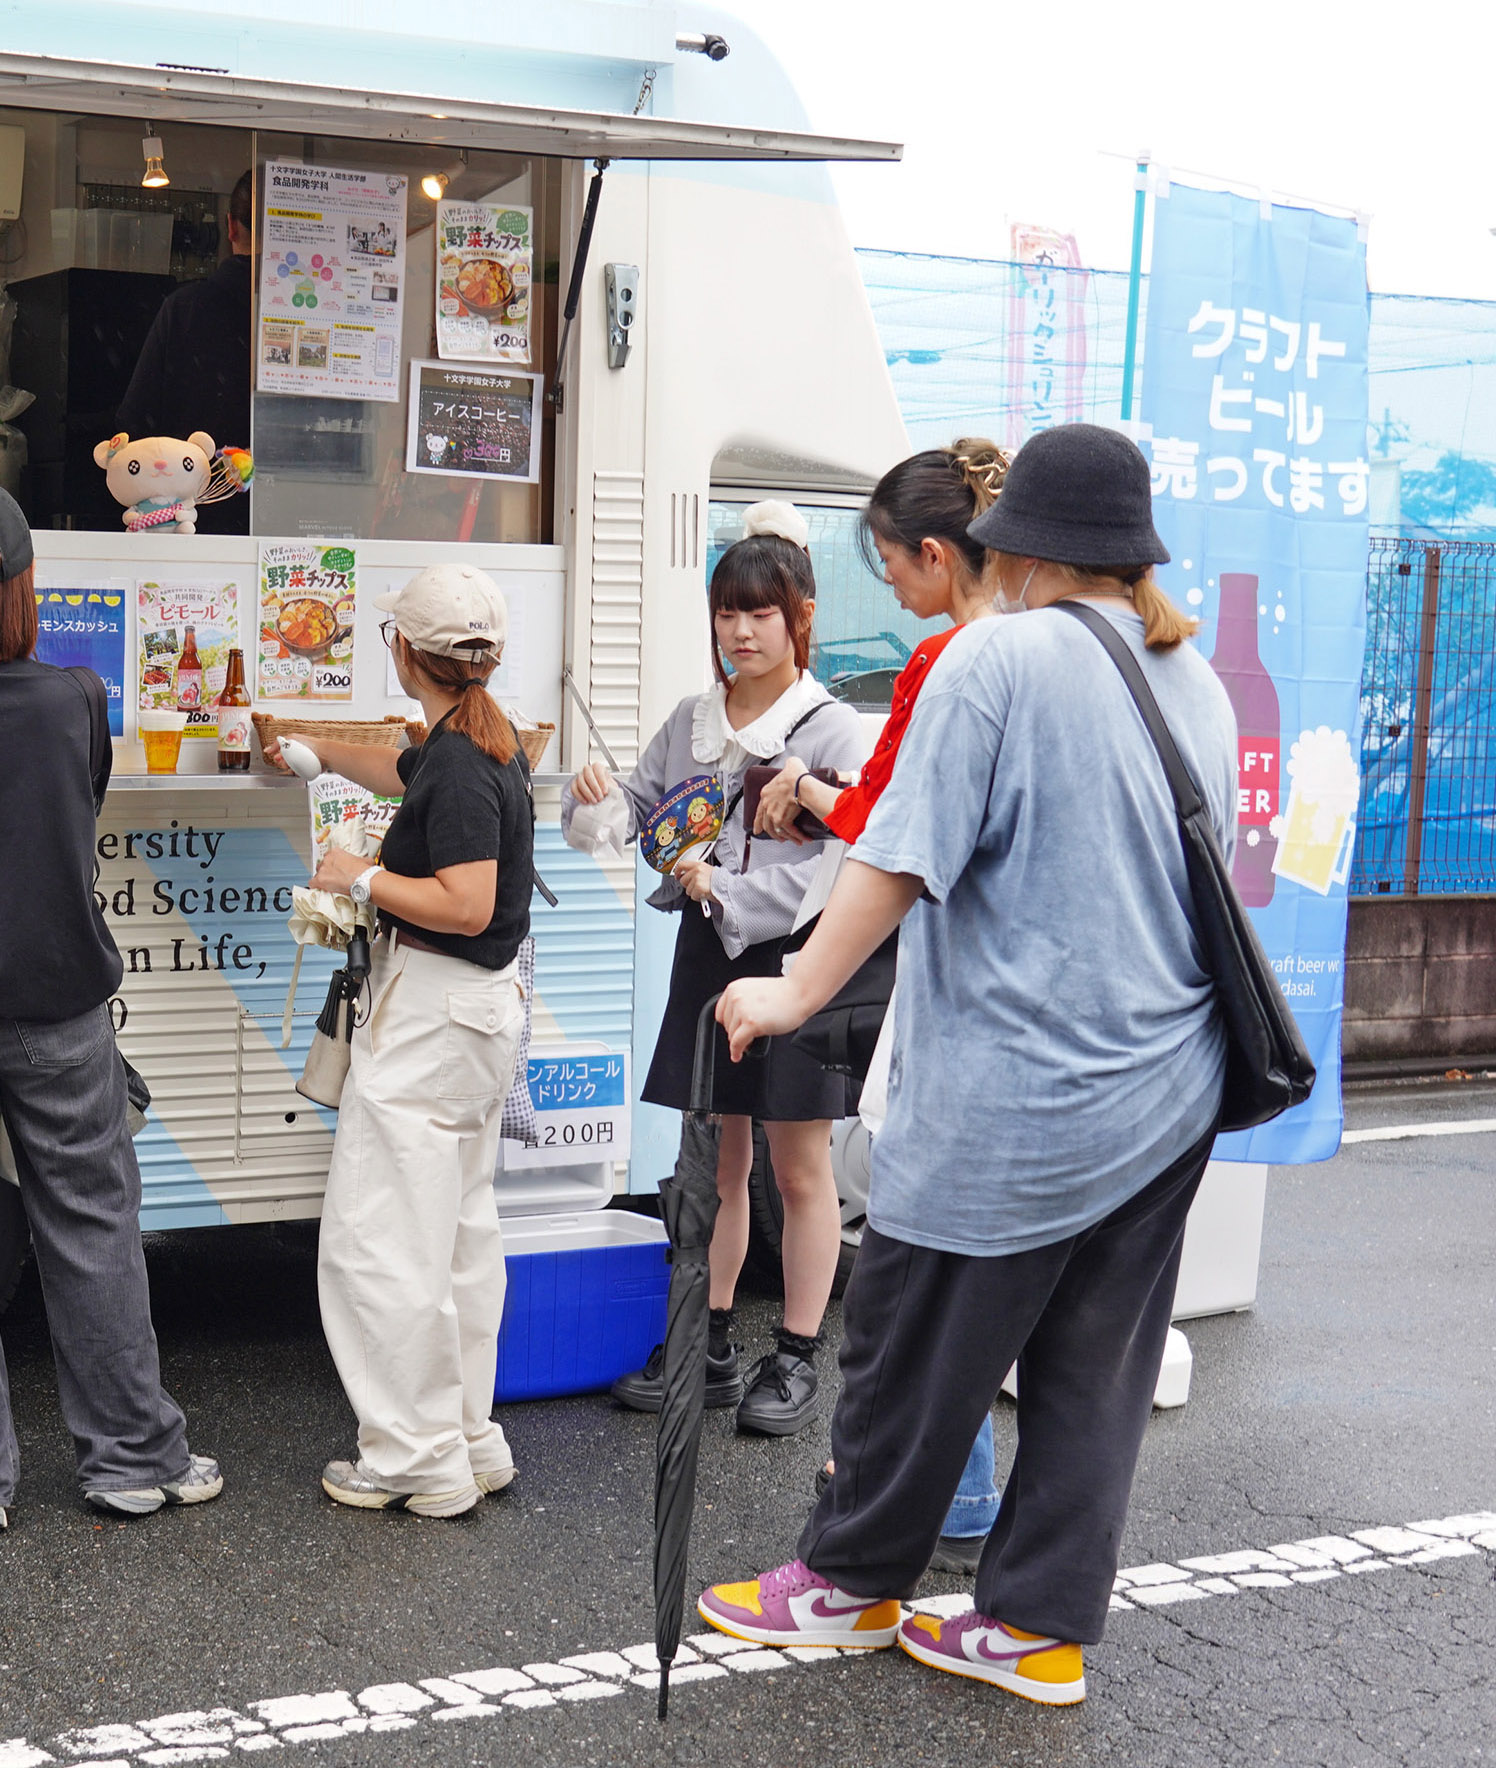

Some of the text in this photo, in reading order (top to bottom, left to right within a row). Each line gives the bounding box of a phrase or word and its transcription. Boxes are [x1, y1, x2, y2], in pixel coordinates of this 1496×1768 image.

[272, 175, 329, 192] 食品開発学科
[445, 225, 523, 252] 野菜チップス
[1187, 300, 1347, 379] クラフト
[443, 373, 512, 389] 十文字学園女子大学
[432, 402, 521, 422] アイスコーヒー
[1209, 372, 1324, 446] ビール
[1150, 437, 1370, 516] 売ってます
[266, 564, 349, 590] 野菜チップス
[174, 593, 204, 602] 共同開発
[159, 603, 221, 621] ピモール
[38, 619, 119, 633] モンスカッシュ
[468, 621, 490, 630] POLO
[315, 672, 351, 688] ¥200
[1238, 788, 1272, 814] ER
[97, 820, 226, 869] ersity
[152, 876, 293, 916] Scienc
[169, 933, 267, 979] Life,
[1268, 954, 1294, 972] raft
[1297, 955, 1326, 973] beer
[1281, 979, 1316, 996] dasai.
[527, 1060, 621, 1083] ンアルコール
[539, 1082, 597, 1104] ドリンク
